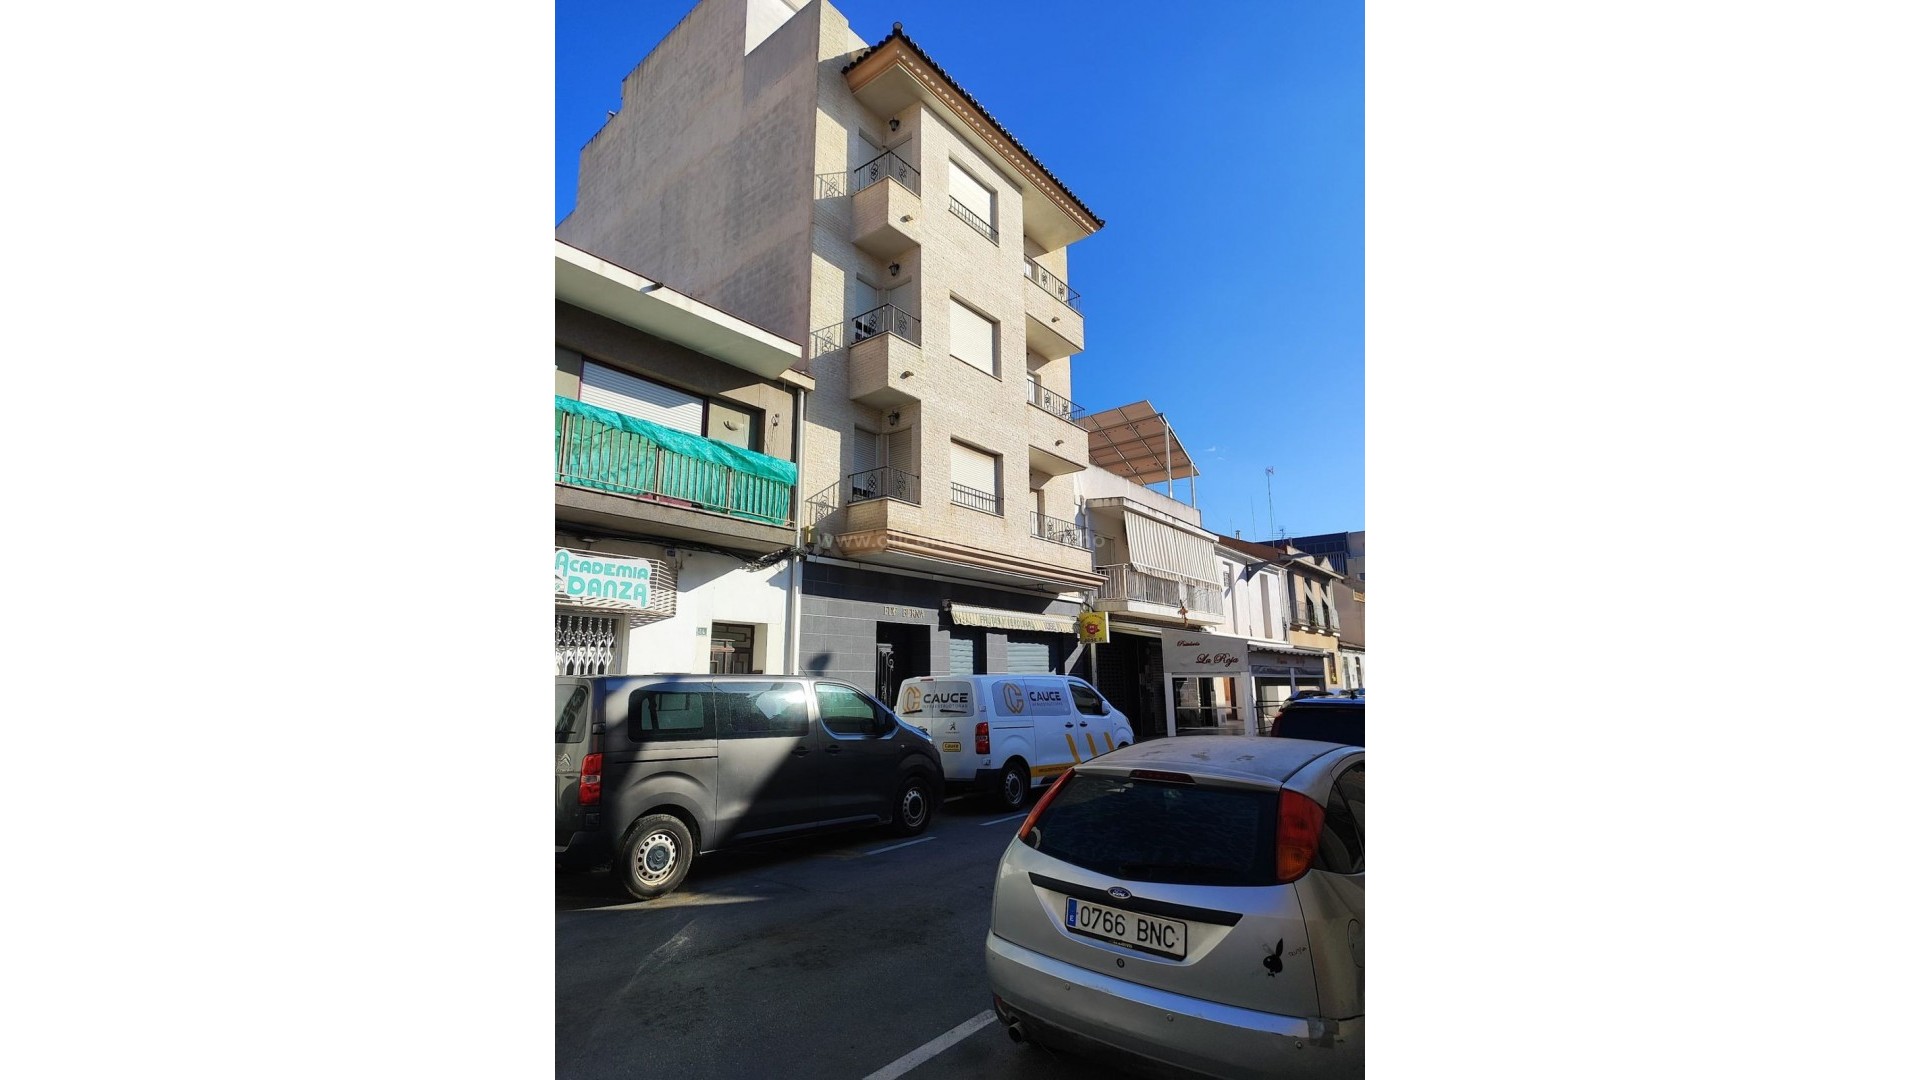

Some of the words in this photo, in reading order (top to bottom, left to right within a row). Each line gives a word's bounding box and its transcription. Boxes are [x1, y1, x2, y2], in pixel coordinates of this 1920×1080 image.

[555, 551, 649, 580] ACADEMIA
[567, 575, 647, 607] DANZA
[1196, 653, 1211, 664] La
[923, 692, 969, 704] CAUCE
[1029, 691, 1061, 701] CAUCE
[1080, 905, 1126, 937] 0766
[1137, 918, 1175, 948] BNC
